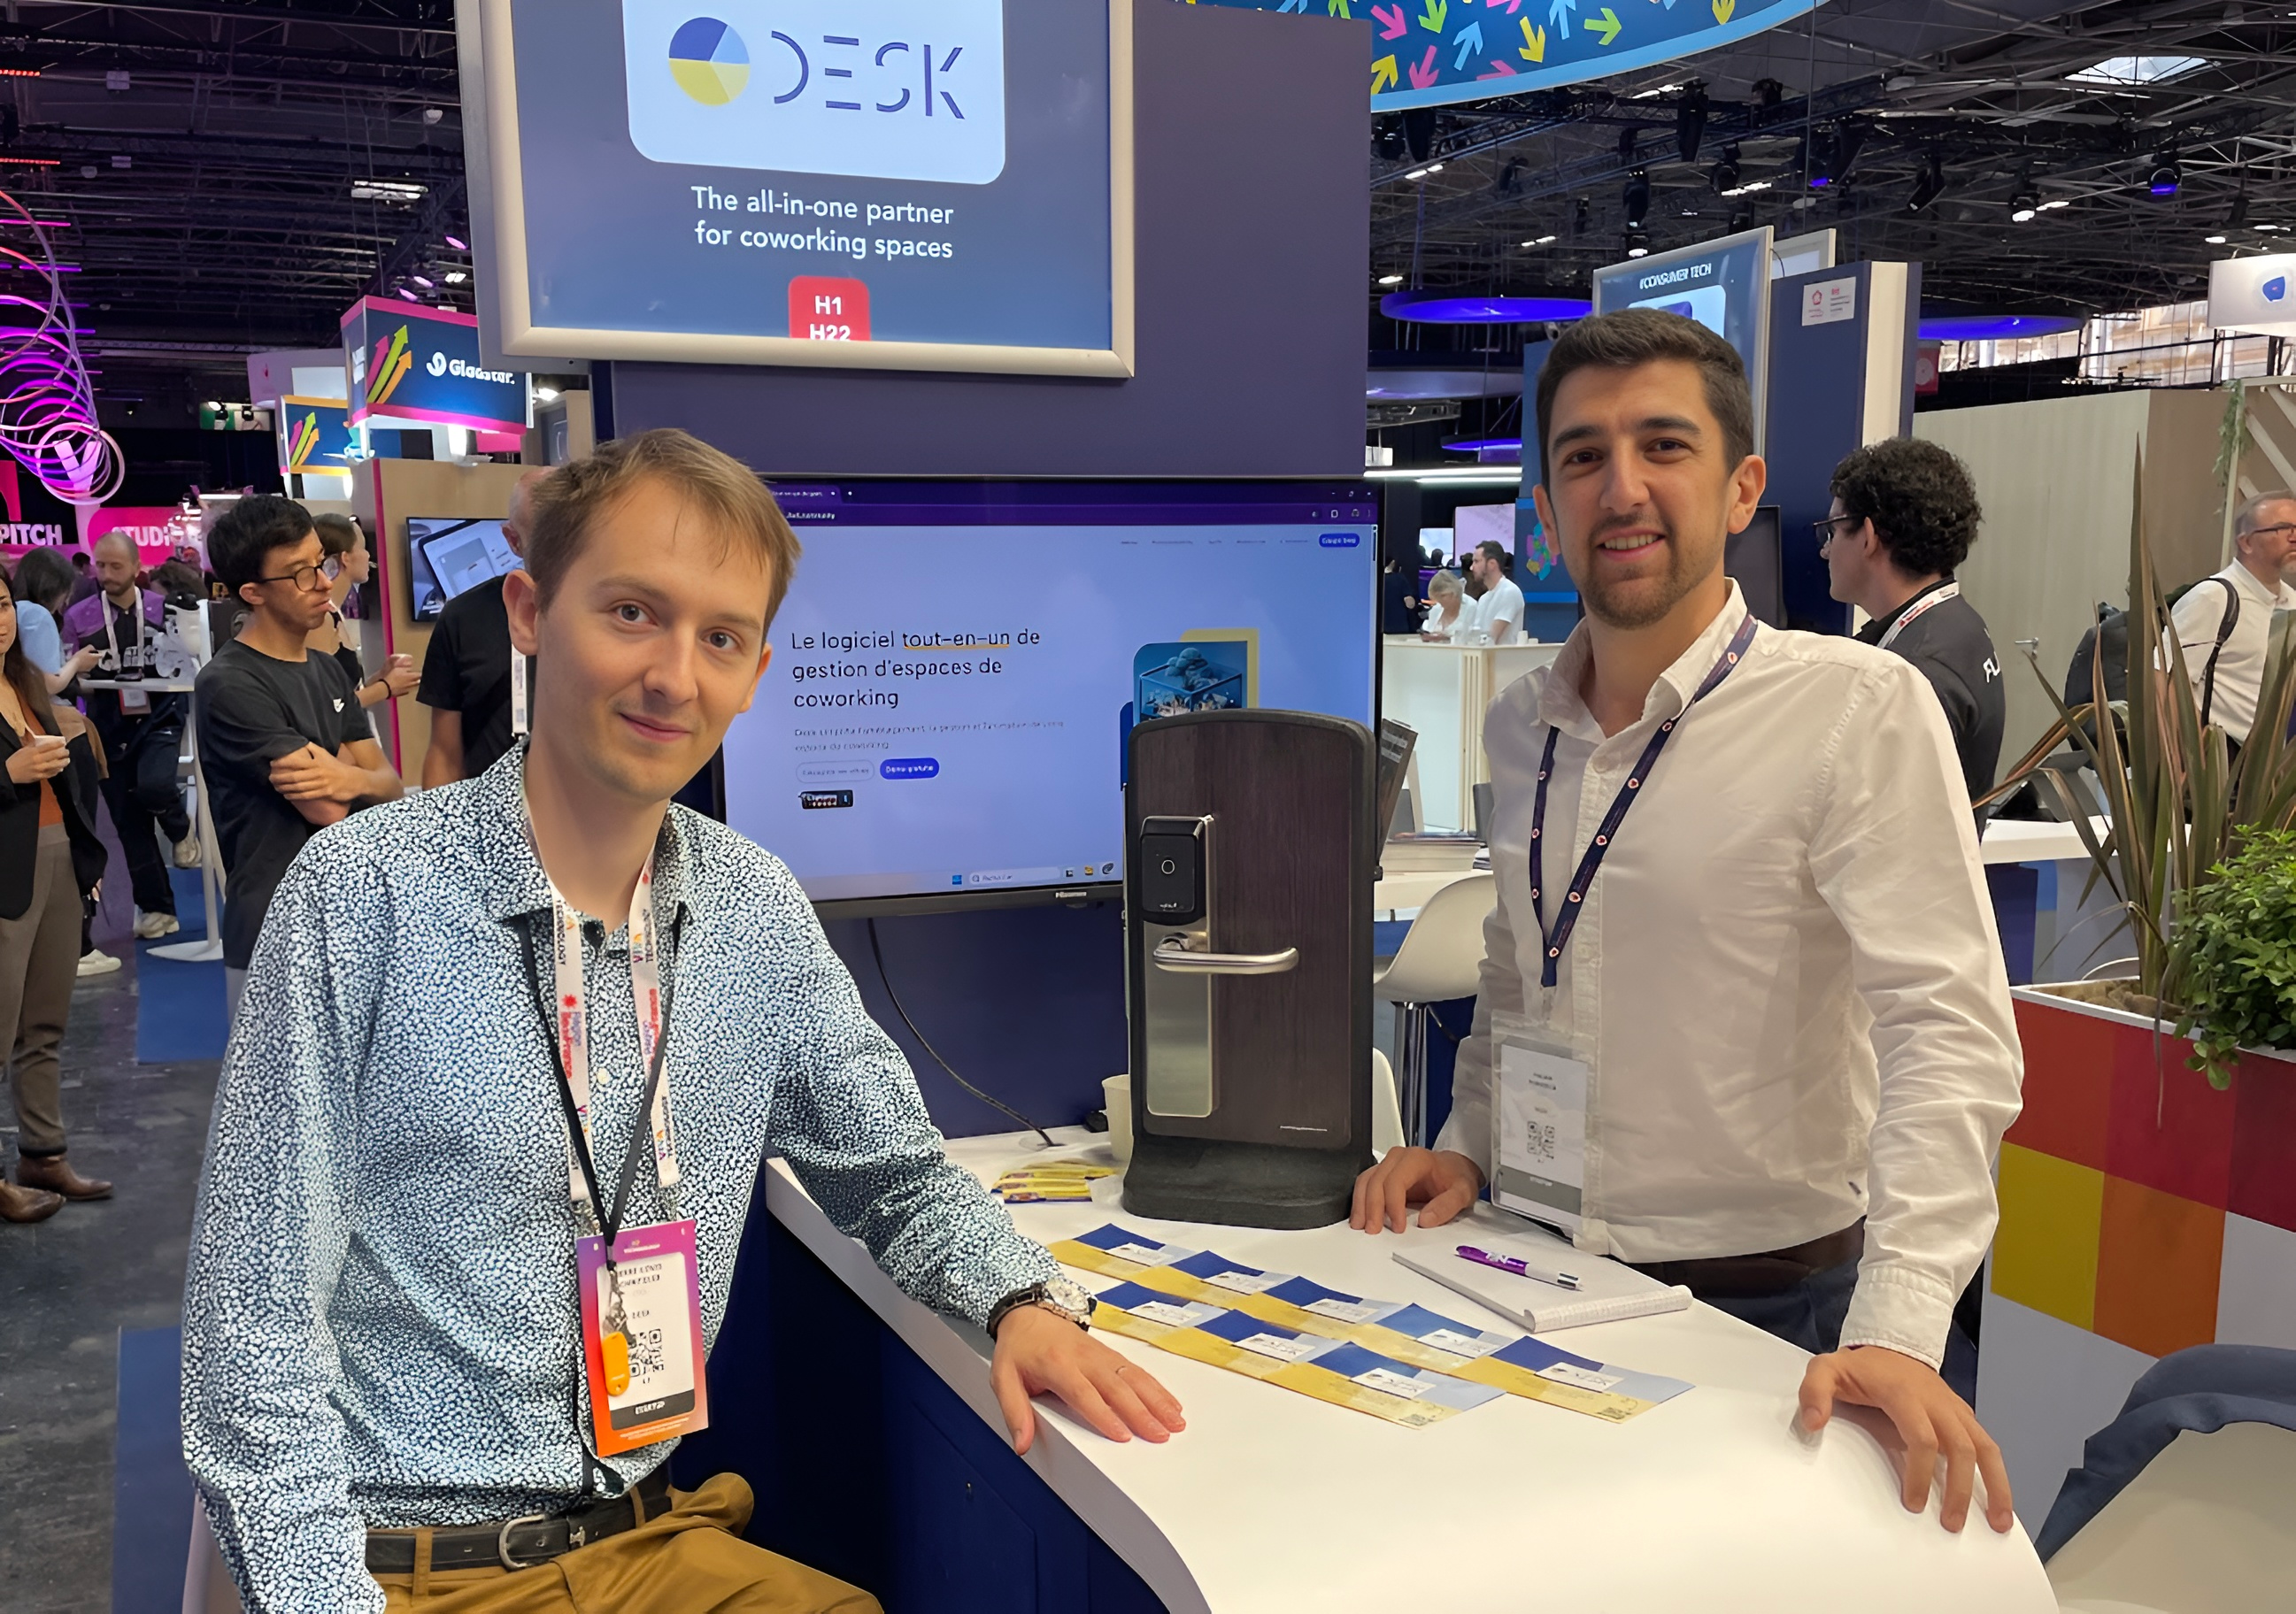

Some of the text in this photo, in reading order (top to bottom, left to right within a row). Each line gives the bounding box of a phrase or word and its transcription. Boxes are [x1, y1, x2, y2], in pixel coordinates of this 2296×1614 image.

[771, 30, 965, 119] DESK
[690, 186, 953, 226] The all-in-one partner
[694, 220, 953, 260] for coworking spaces
[815, 295, 842, 315] H1
[809, 323, 851, 342] H22
[791, 628, 1040, 652] Le logiciel tout-en-un de
[792, 657, 1002, 682] gestion d'espaces de
[794, 689, 898, 709] coworking
